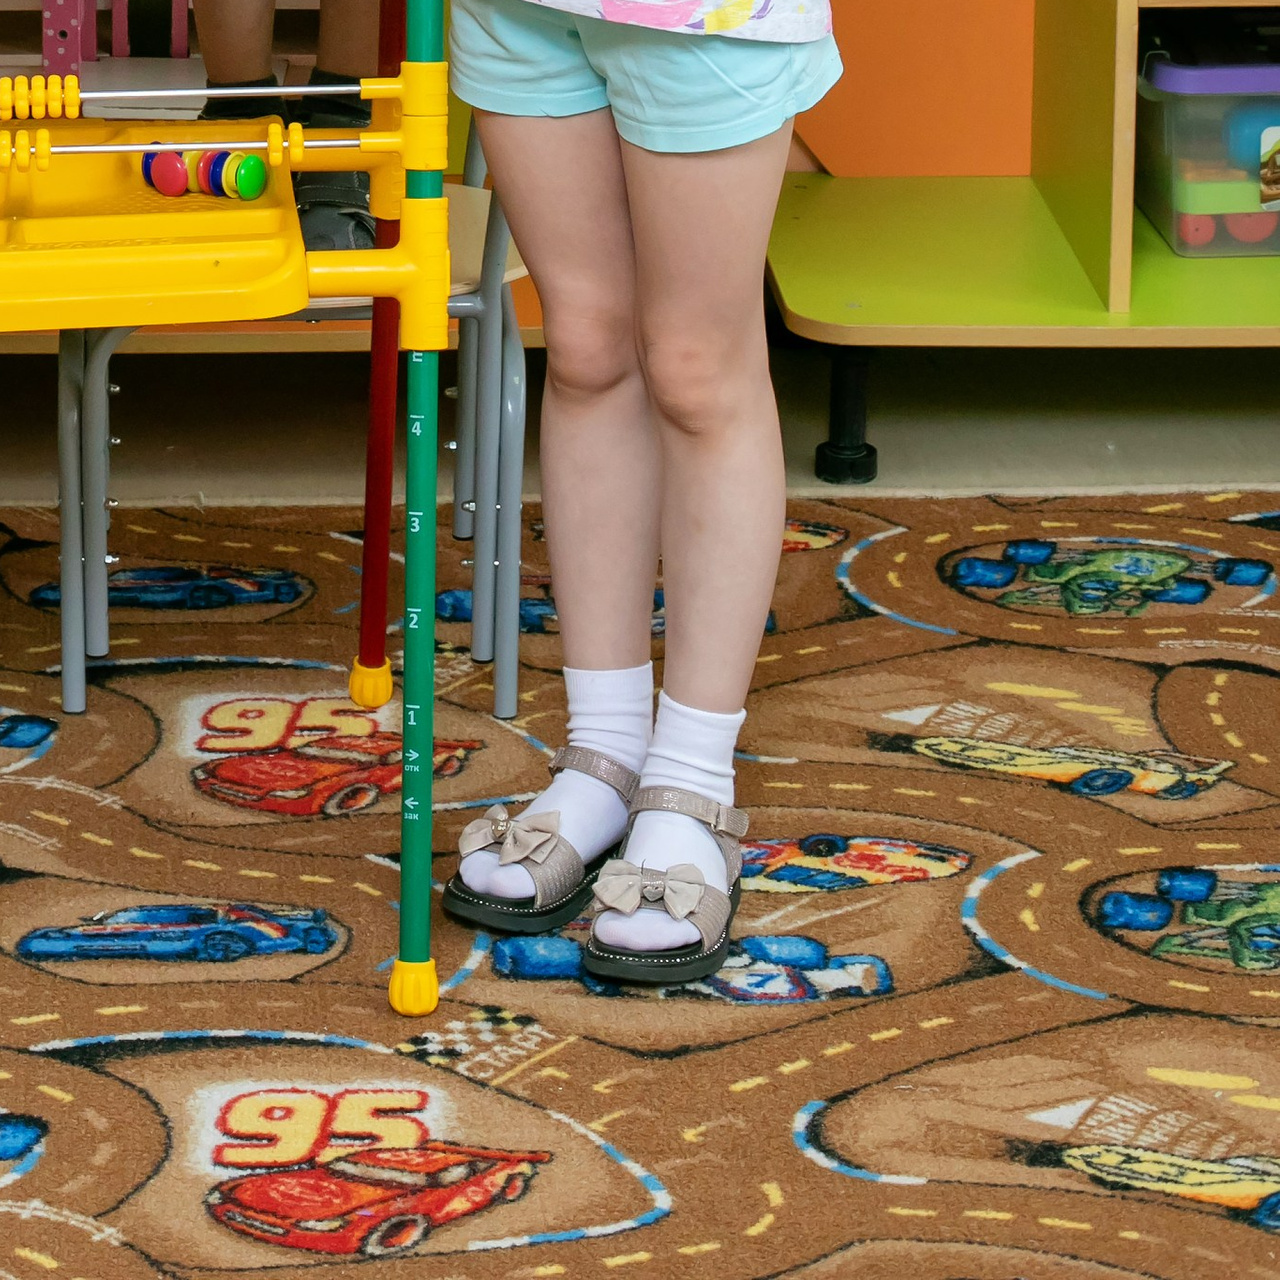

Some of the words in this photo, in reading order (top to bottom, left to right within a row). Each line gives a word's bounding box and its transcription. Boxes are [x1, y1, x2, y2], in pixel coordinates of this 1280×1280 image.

[411, 421, 422, 436] 4
[410, 518, 420, 533] 3
[408, 614, 419, 629] 2
[194, 696, 380, 753] 95
[407, 710, 417, 725] 1
[212, 1087, 430, 1168] 95
